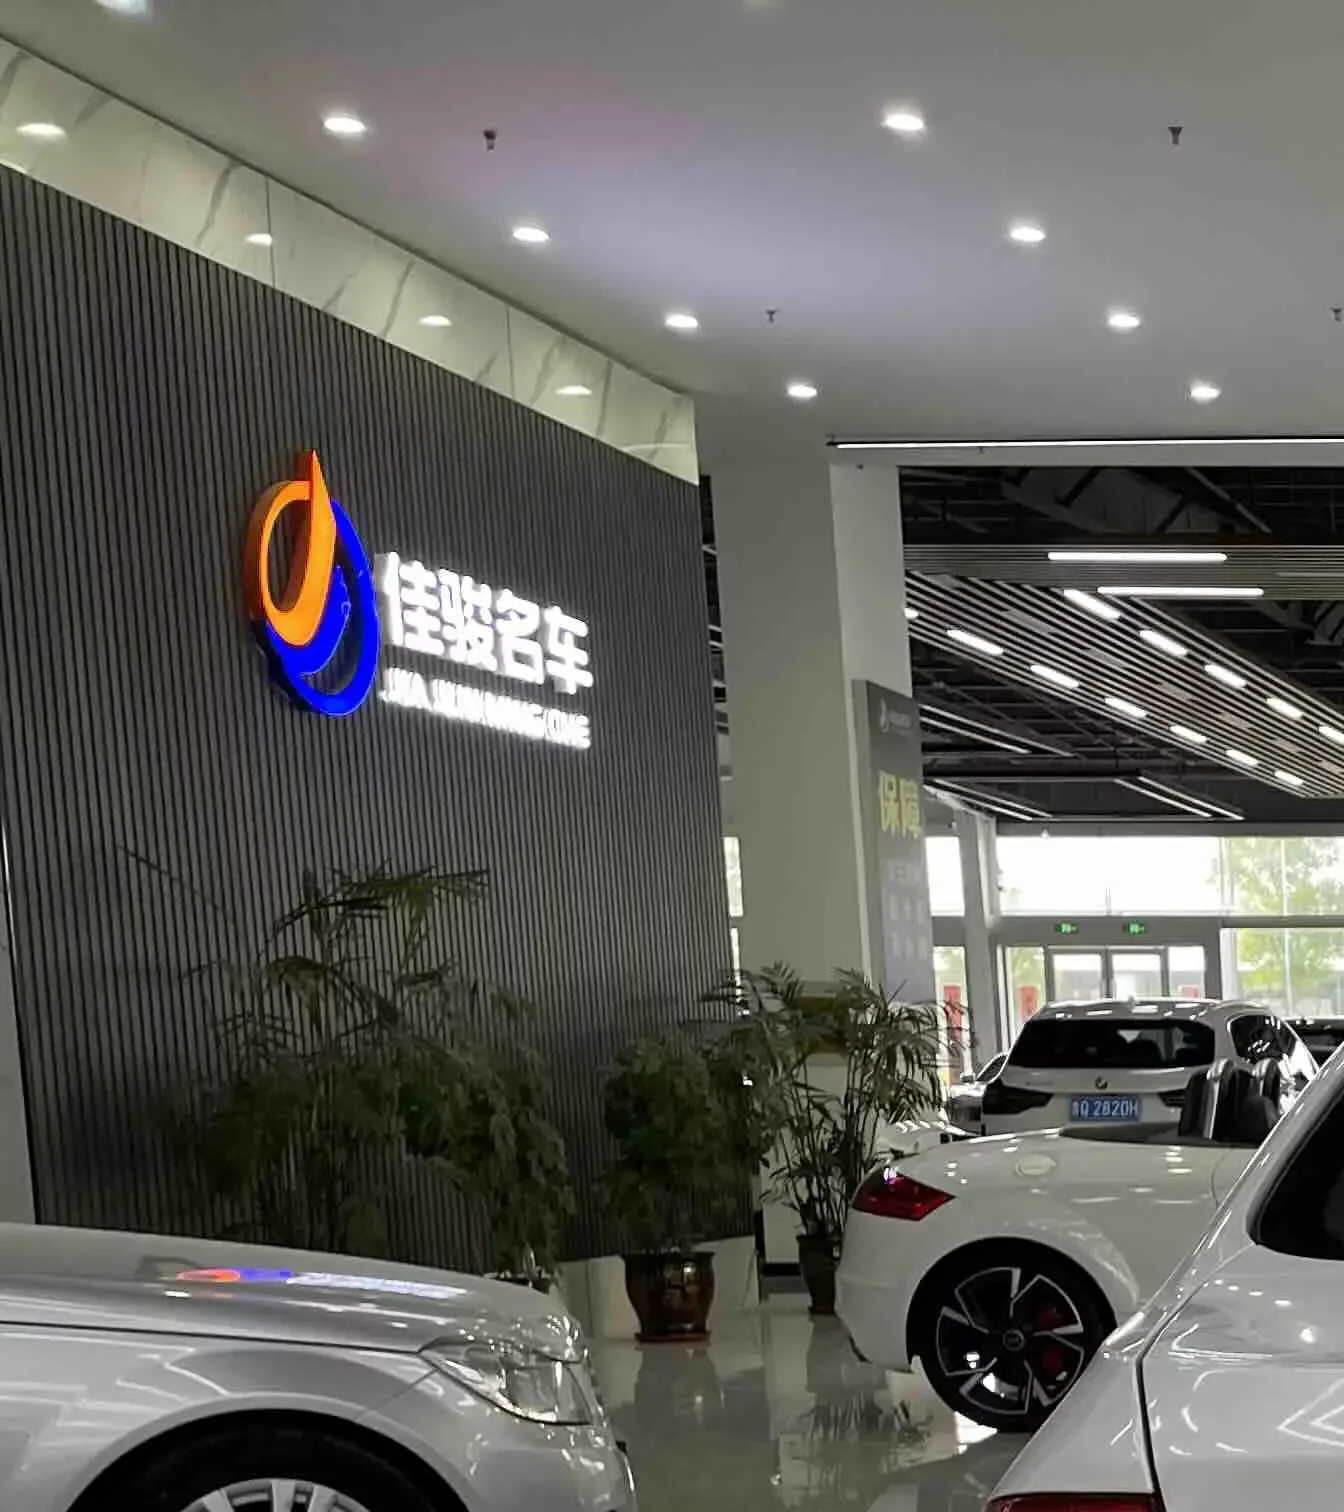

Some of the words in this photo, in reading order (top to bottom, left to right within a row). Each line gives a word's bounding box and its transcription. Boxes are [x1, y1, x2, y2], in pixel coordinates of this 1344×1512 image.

[383, 551, 594, 695] 佳骏名车
[877, 770, 922, 838] 保障
